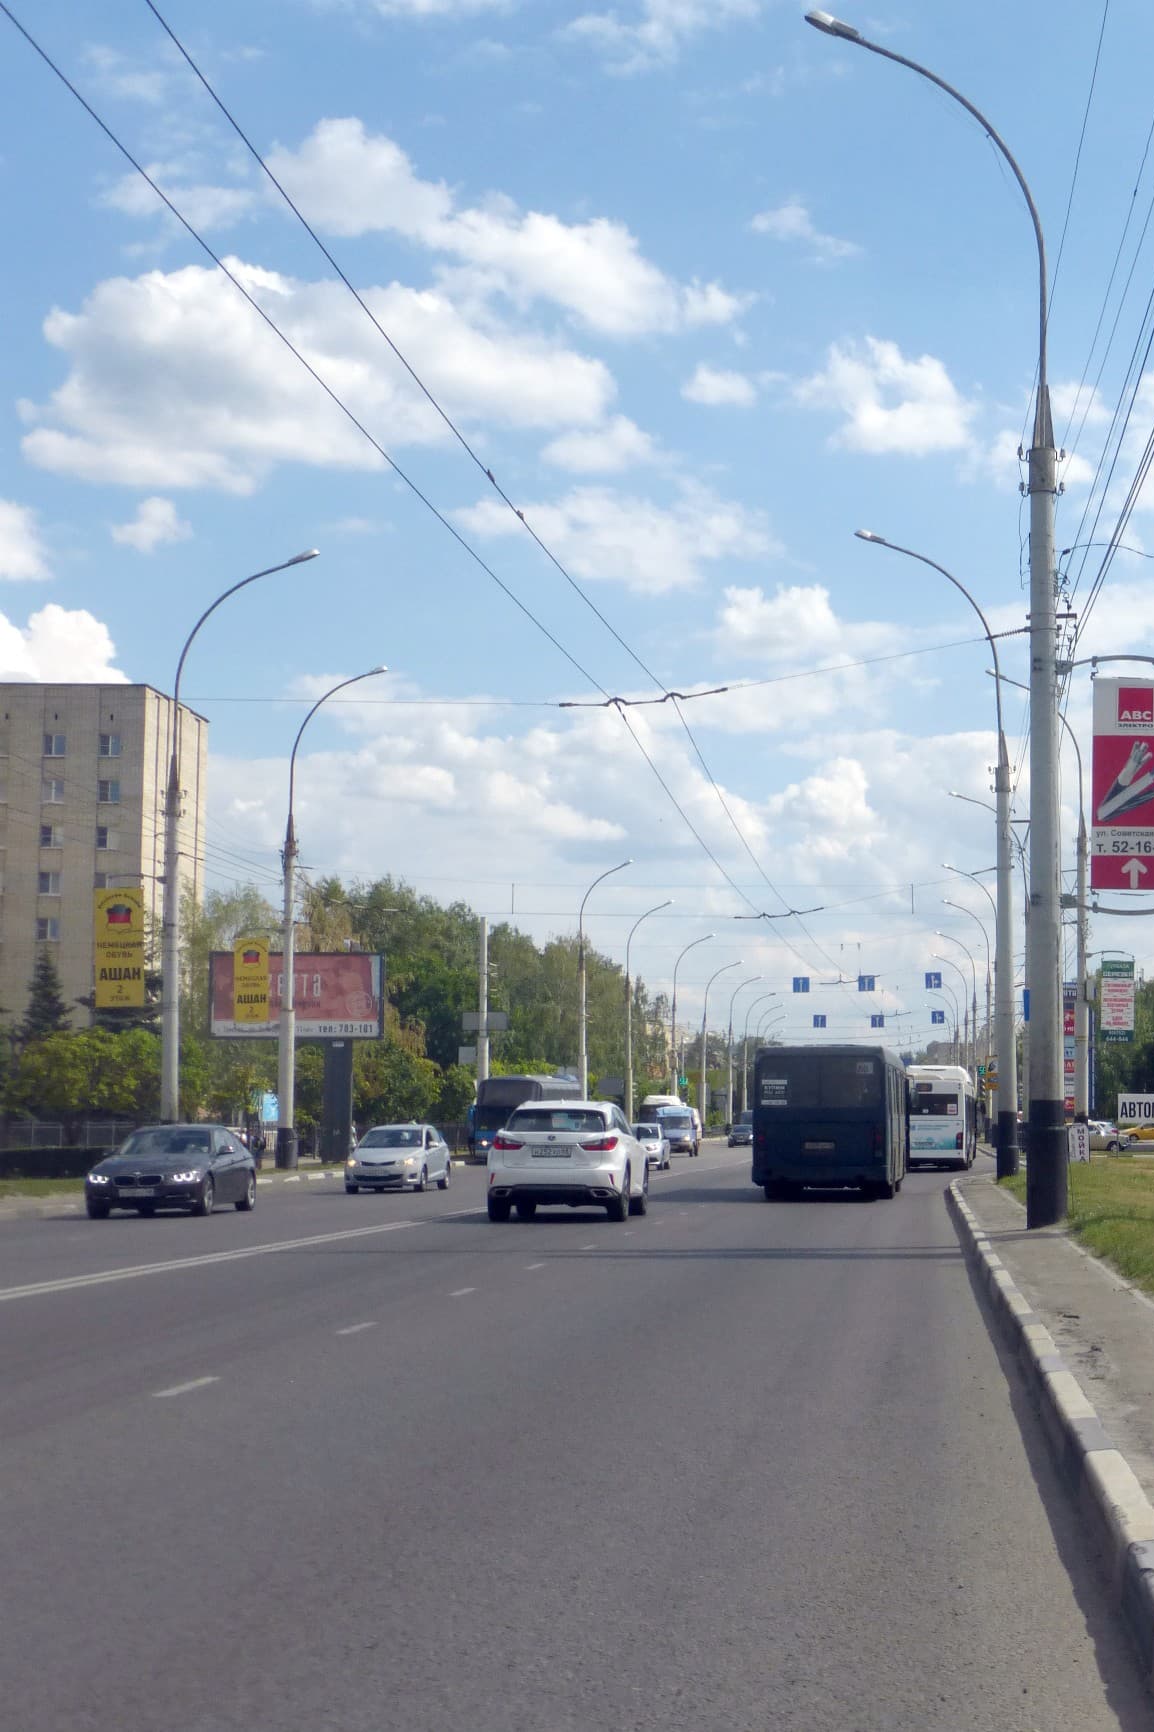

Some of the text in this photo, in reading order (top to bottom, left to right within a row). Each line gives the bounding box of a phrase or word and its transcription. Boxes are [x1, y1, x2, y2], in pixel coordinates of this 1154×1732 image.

[1096, 844, 1107, 853] т.
[99, 967, 141, 981] АШАН
[116, 985, 123, 993] 2
[236, 994, 267, 1004] АШАН
